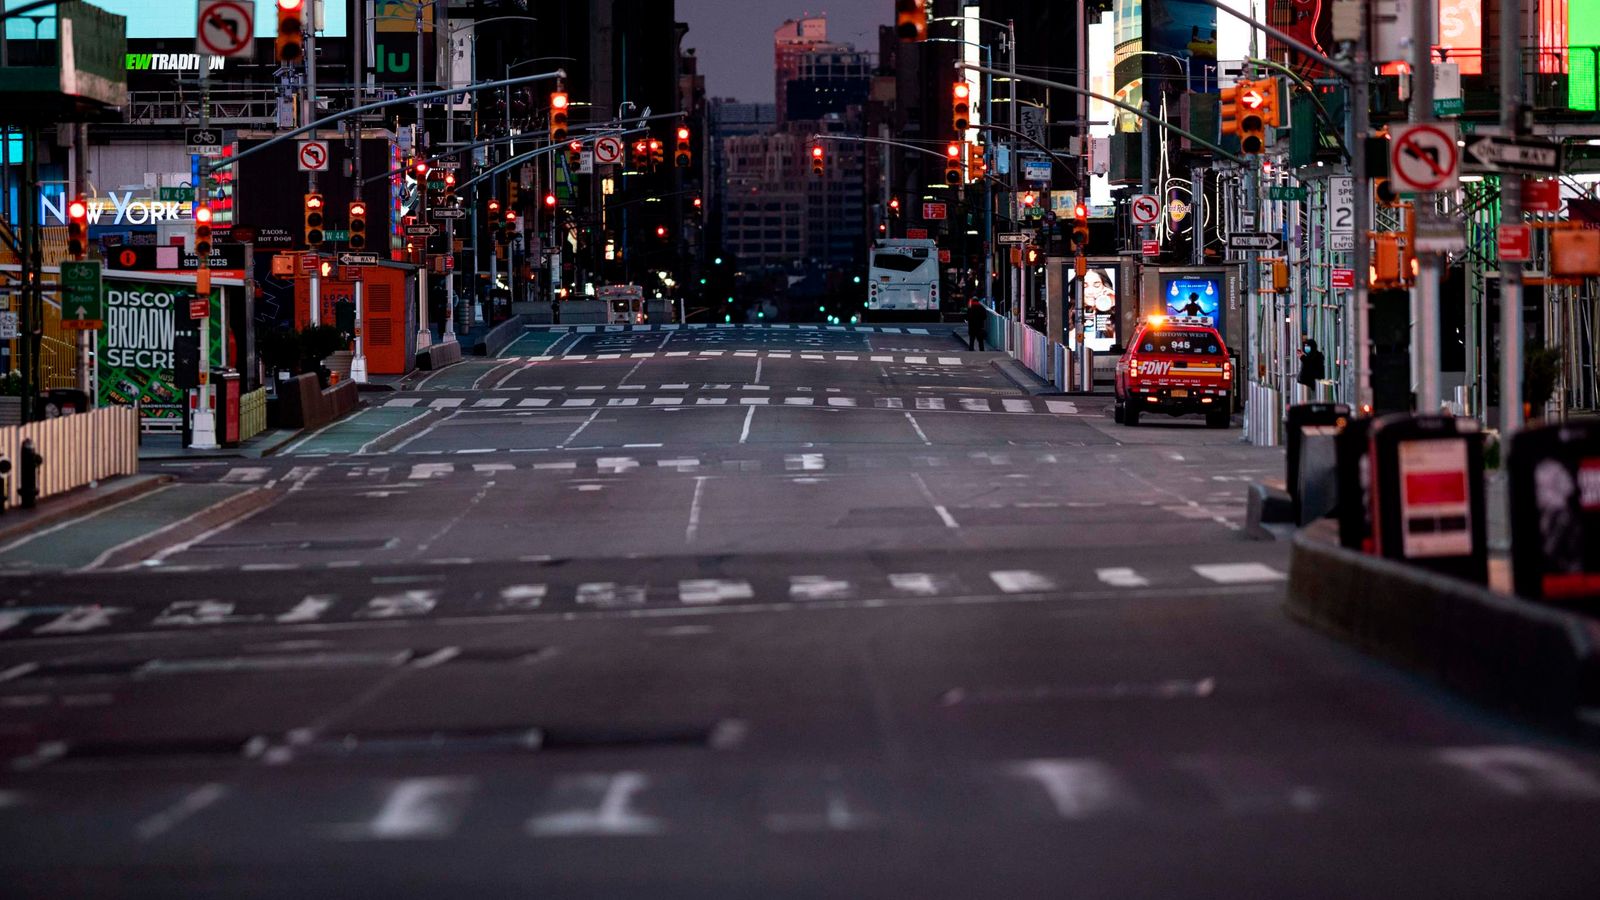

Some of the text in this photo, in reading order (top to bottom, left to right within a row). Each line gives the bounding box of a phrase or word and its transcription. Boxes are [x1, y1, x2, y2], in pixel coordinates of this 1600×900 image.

[126, 53, 225, 71] EWTRADITON
[1477, 145, 1548, 160] ONE WAY
[161, 189, 170, 200] W
[174, 189, 185, 200] 45
[1271, 188, 1280, 199] W
[1284, 188, 1295, 199] 45
[1338, 188, 1354, 196] SPE
[42, 192, 181, 226] NW YORK
[1336, 207, 1352, 227] 2
[326, 231, 345, 240] W 44
[1236, 237, 1274, 246] ONE WAY
[183, 258, 229, 267] SEICES
[108, 290, 175, 308] DISCO
[108, 307, 175, 351] BROADW
[1170, 341, 1191, 349] 945
[107, 348, 175, 369] SECRE
[1139, 360, 1173, 375] FDNY
